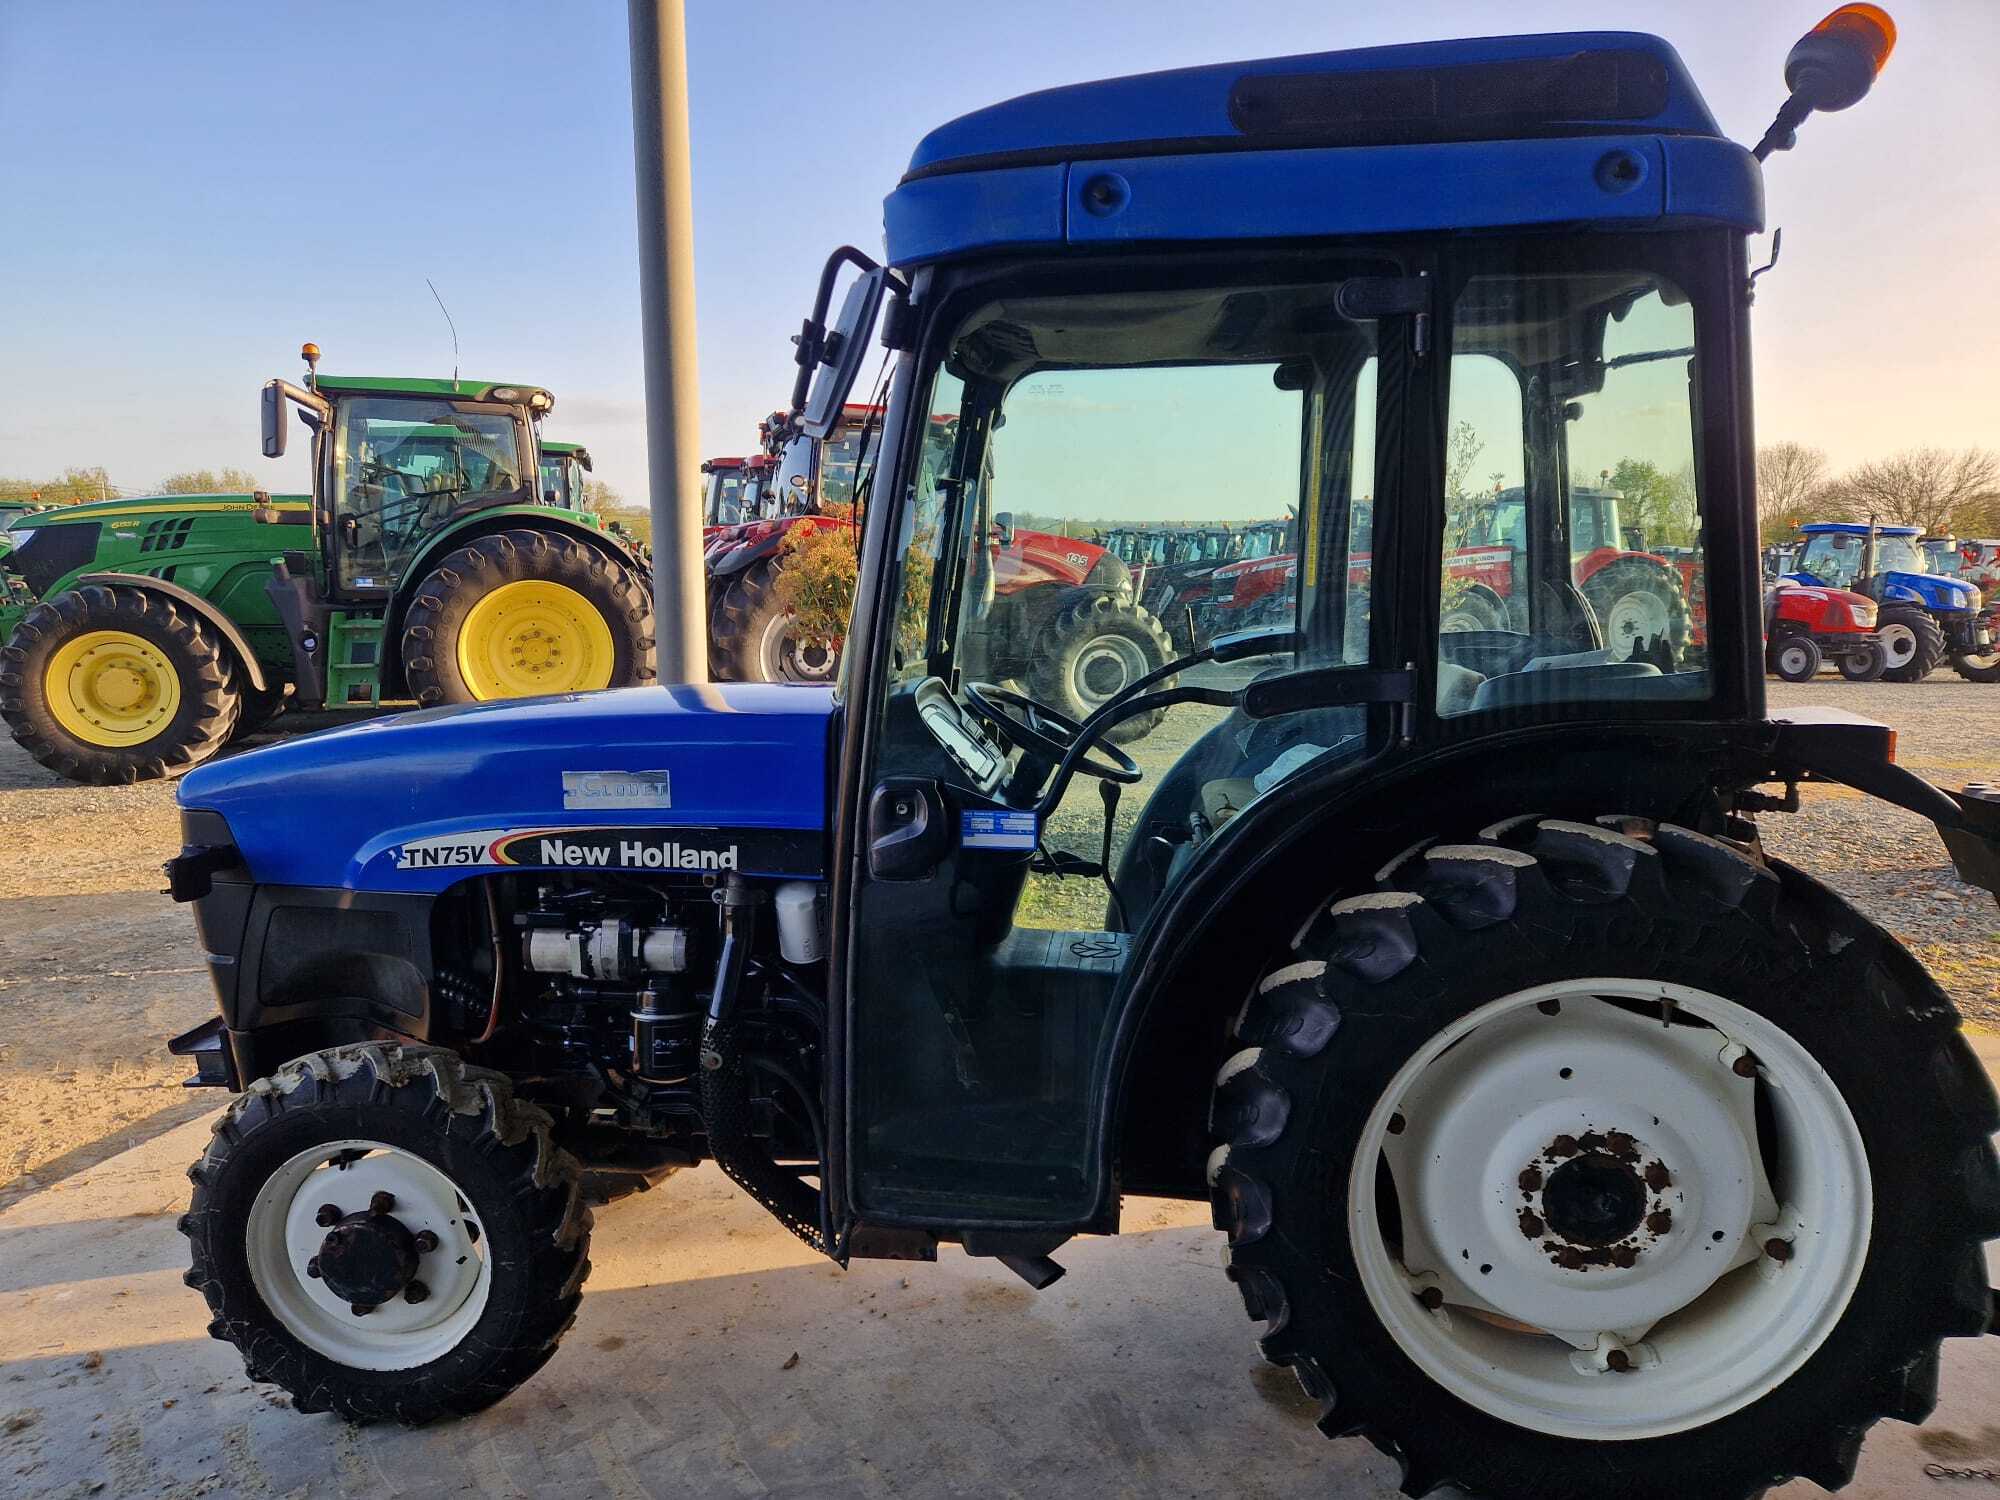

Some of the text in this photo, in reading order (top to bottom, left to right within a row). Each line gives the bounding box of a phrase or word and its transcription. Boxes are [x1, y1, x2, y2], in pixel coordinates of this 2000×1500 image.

[223, 503, 245, 511] JOHN
[406, 839, 738, 870] TN75V New Holland
